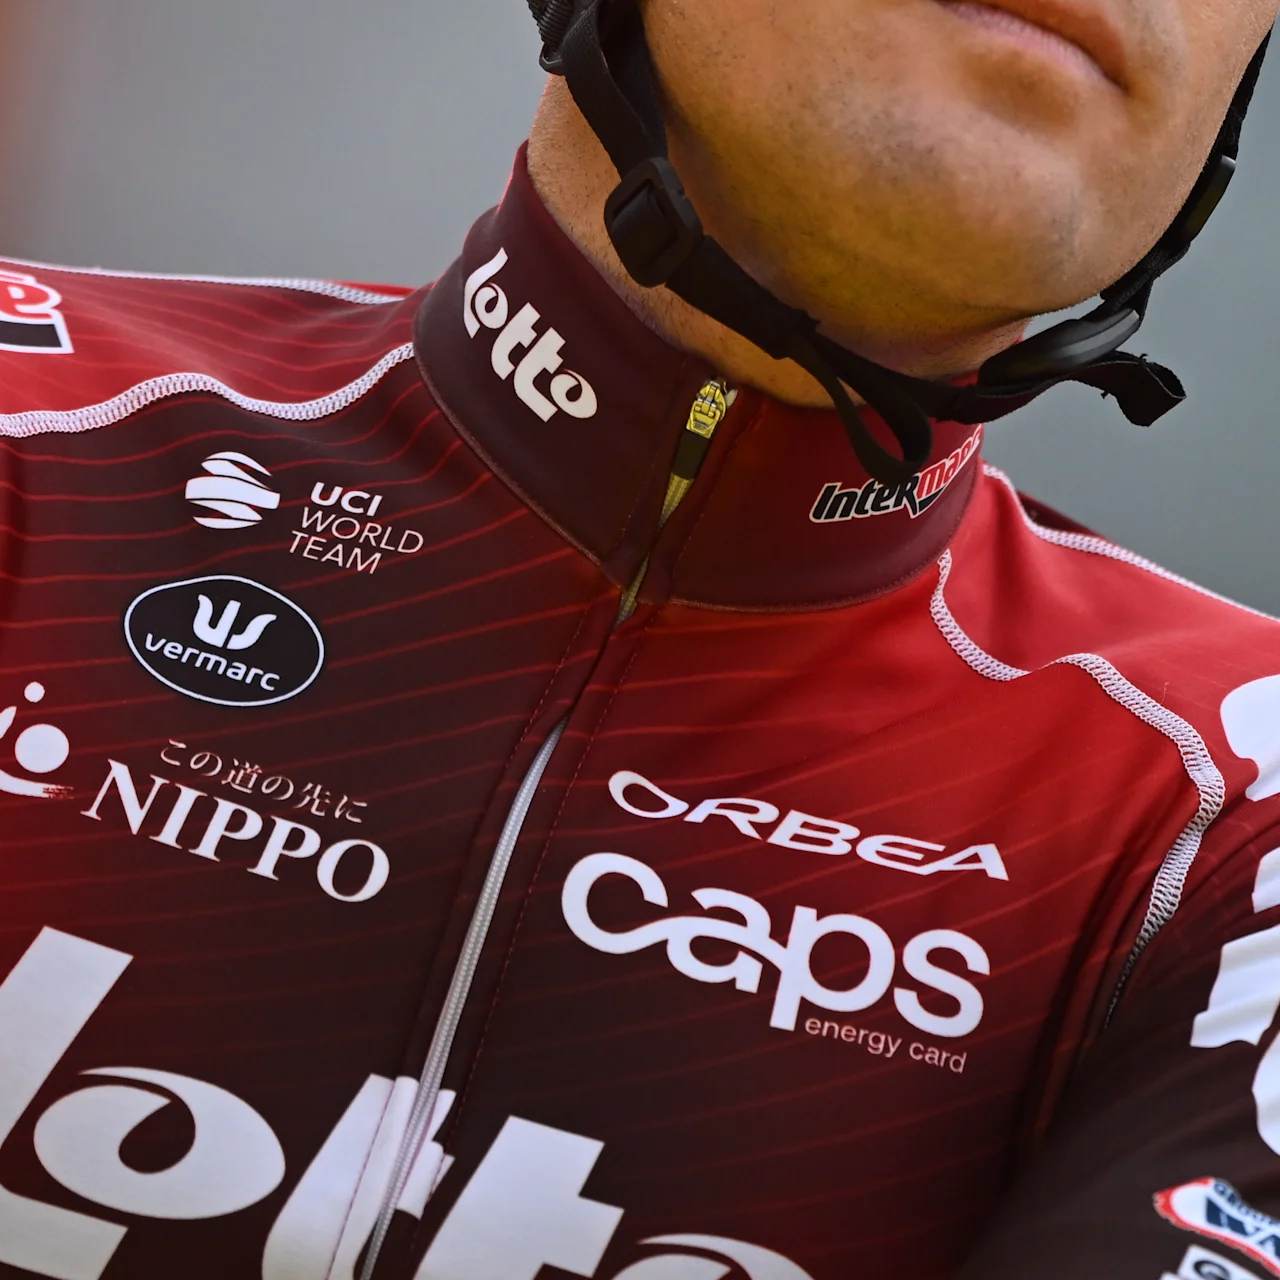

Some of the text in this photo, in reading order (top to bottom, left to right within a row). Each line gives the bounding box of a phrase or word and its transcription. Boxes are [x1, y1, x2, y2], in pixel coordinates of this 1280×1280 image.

[310, 481, 382, 518] UCI
[289, 530, 382, 575] TEAM
[300, 506, 425, 554] WORLD
[144, 632, 280, 692] vermarc
[160, 738, 368, 824] この道の先に
[80, 759, 390, 903] NIPPO
[608, 770, 1010, 881] ORBEA
[561, 852, 991, 1038] caps
[805, 1018, 967, 1074] energy card
